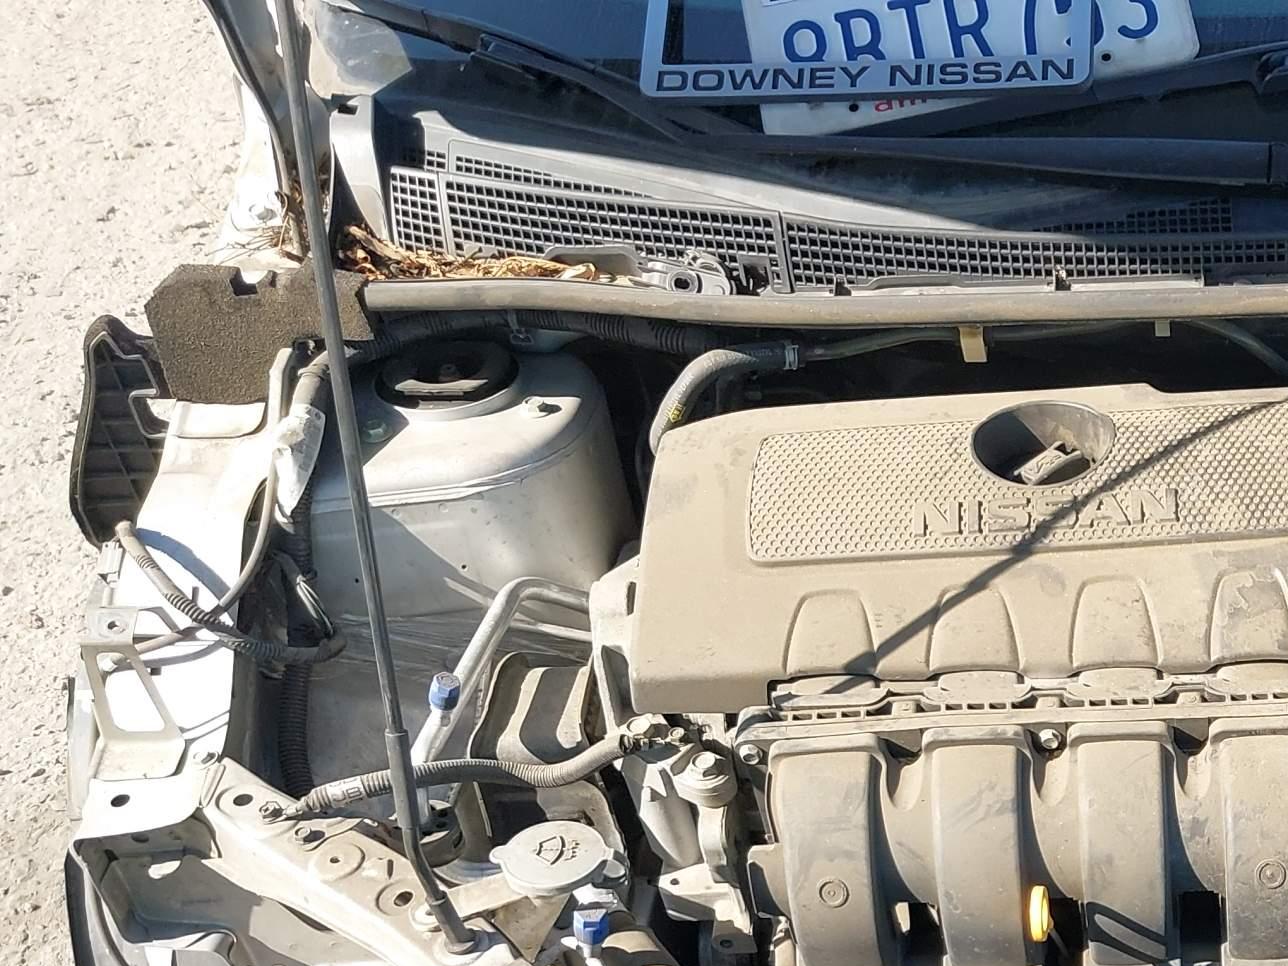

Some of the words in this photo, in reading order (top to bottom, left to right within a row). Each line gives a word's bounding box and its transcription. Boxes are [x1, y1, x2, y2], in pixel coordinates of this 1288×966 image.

[656, 66, 871, 91] DOWNEY
[889, 59, 1074, 86] NISSAN
[913, 488, 1179, 537] NISSAN
